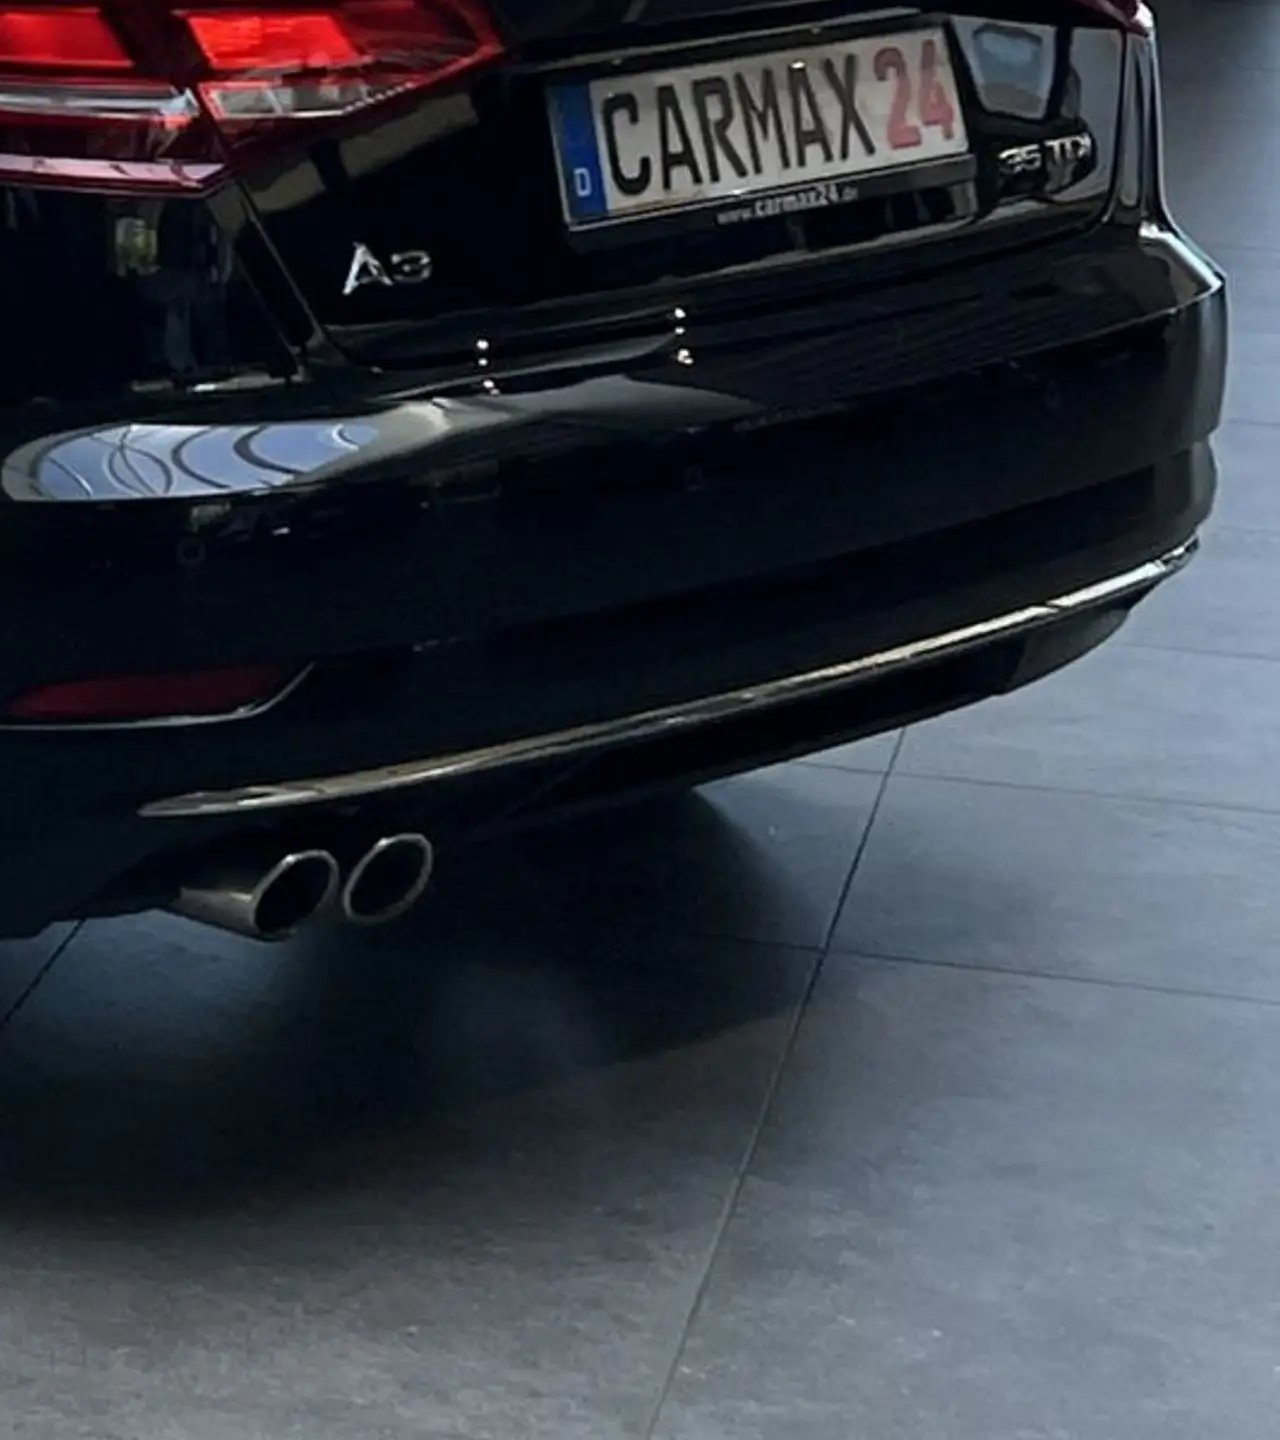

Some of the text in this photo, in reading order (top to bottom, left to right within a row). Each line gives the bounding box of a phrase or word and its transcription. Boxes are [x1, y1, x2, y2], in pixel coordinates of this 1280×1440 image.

[600, 38, 956, 197] CARMAX24
[574, 167, 592, 197] D
[341, 241, 432, 296] A3
